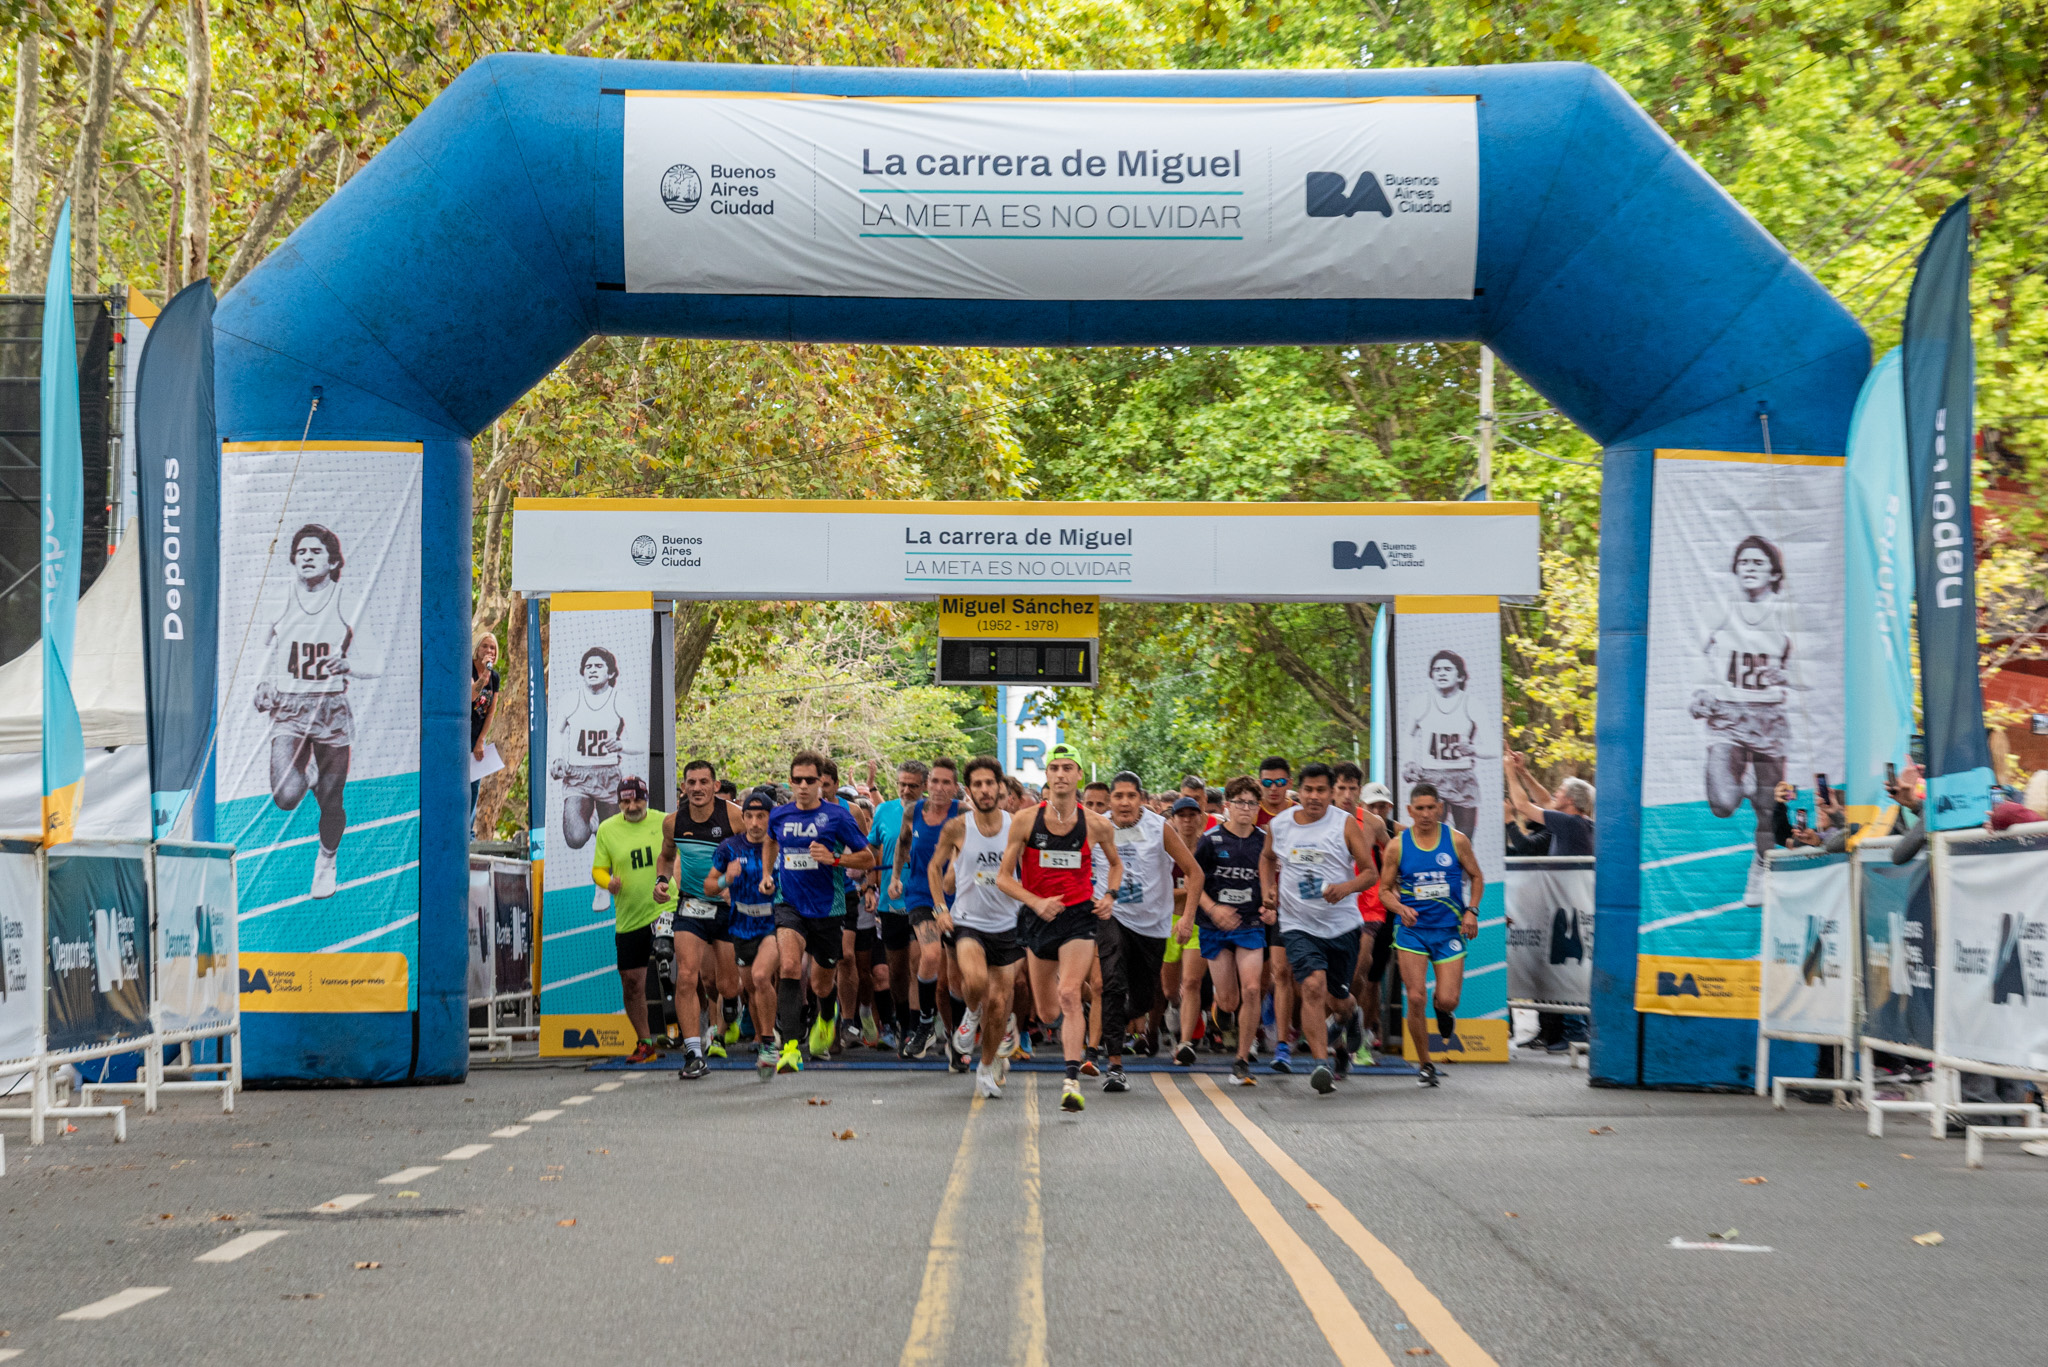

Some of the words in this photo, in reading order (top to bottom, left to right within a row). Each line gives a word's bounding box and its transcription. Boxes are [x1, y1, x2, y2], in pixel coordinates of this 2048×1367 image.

[710, 164, 776, 180] Buenos
[862, 148, 907, 176] La
[916, 153, 1051, 177] carrera
[1061, 149, 1107, 178] de
[1118, 149, 1241, 185] Miguel
[1385, 173, 1440, 186] Buenos
[710, 182, 759, 197] Aires
[1306, 170, 1393, 218] BA
[1394, 187, 1435, 200] Aires
[710, 200, 775, 216] Ciudad
[1398, 200, 1453, 213] Ciudad
[861, 203, 896, 227] LA
[906, 204, 992, 228] META
[1001, 204, 1042, 228] ES
[1051, 204, 1098, 229] NO
[1107, 205, 1242, 229] OLVIDAR
[662, 535, 703, 545] Buenos
[905, 527, 932, 545] La
[939, 529, 1018, 545] carrera
[1025, 528, 1052, 546] de
[1059, 528, 1133, 549] Miguel
[163, 457, 185, 640] Deportes
[661, 546, 692, 556] Aires
[1382, 542, 1417, 551] Buenos
[661, 557, 701, 567] Ciudad
[1333, 540, 1387, 570] BA
[1388, 551, 1414, 559] Aires
[905, 560, 926, 574] LA
[932, 560, 983, 575] META
[988, 561, 1012, 575] ES
[1018, 561, 1046, 576] NO
[1051, 562, 1131, 576] OLVIDAR
[1391, 559, 1425, 567] Ciudad
[942, 598, 1005, 617] Miguel
[1012, 597, 1094, 614] Sánchez
[977, 619, 1012, 633] (1952
[1024, 620, 1059, 633] 1978)
[287, 640, 330, 681] 422
[1727, 650, 1770, 691] 422
[577, 729, 608, 757] 422
[1430, 732, 1461, 760] 422
[783, 822, 818, 838] FILA
[793, 860, 807, 868] 550
[1052, 858, 1069, 866] 521
[52, 935, 90, 978] Deportes
[268, 969, 296, 978] Buenos
[272, 977, 293, 985] Aires
[274, 984, 302, 992] Ciudad
[320, 977, 349, 986] Vamos
[350, 977, 366, 988] por
[367, 976, 386, 985] más
[563, 1028, 600, 1049] BA
